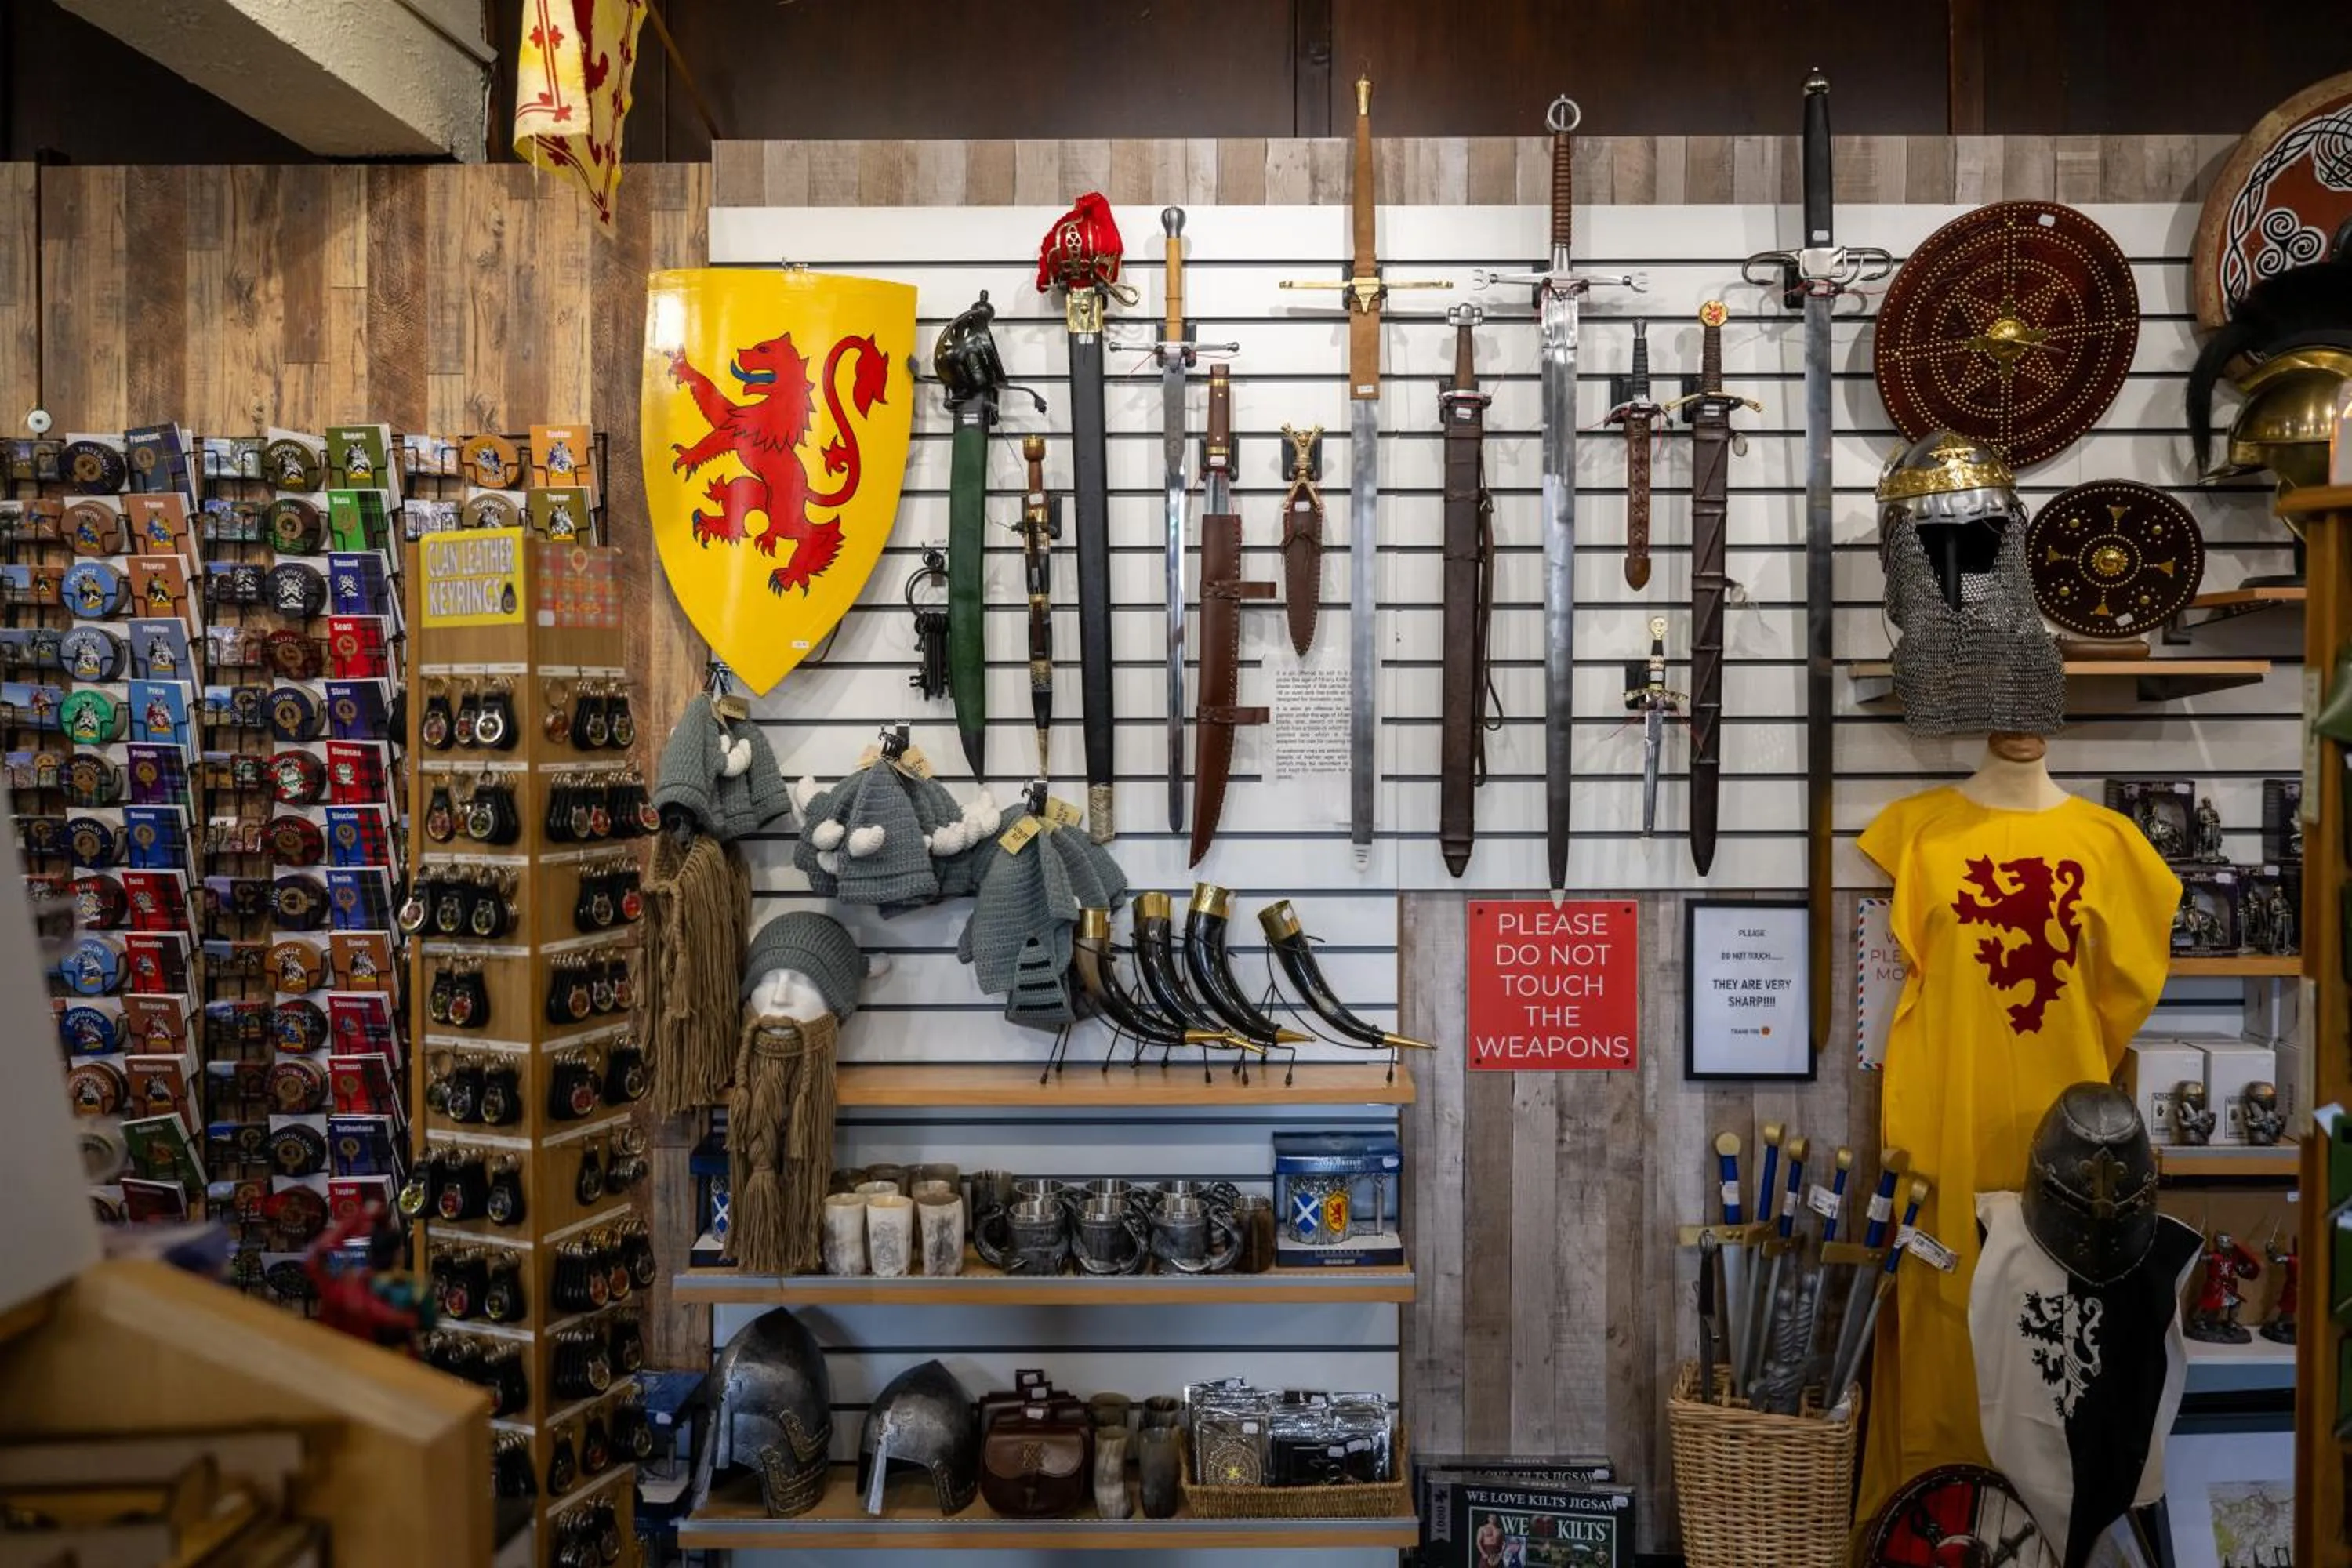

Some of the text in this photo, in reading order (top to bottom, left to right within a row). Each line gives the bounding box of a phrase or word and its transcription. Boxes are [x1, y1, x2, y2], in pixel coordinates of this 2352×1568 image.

[427, 536, 515, 577] CLAN LEATHER
[429, 579, 503, 616] KEYRINGS
[1498, 913, 1609, 935] PLEASE
[1496, 944, 1612, 966] DO NOT
[1500, 975, 1604, 996] TOUCH
[1713, 979, 1791, 990] THEY ARE VERY
[1523, 1006, 1581, 1027] THE
[1475, 1036, 1629, 1058] WEAPONS
[1466, 1490, 1488, 1502] WE
[1490, 1492, 1526, 1505] LOVE
[1528, 1494, 1566, 1508] KILTS
[1500, 1515, 1606, 1542] WE KILTS
